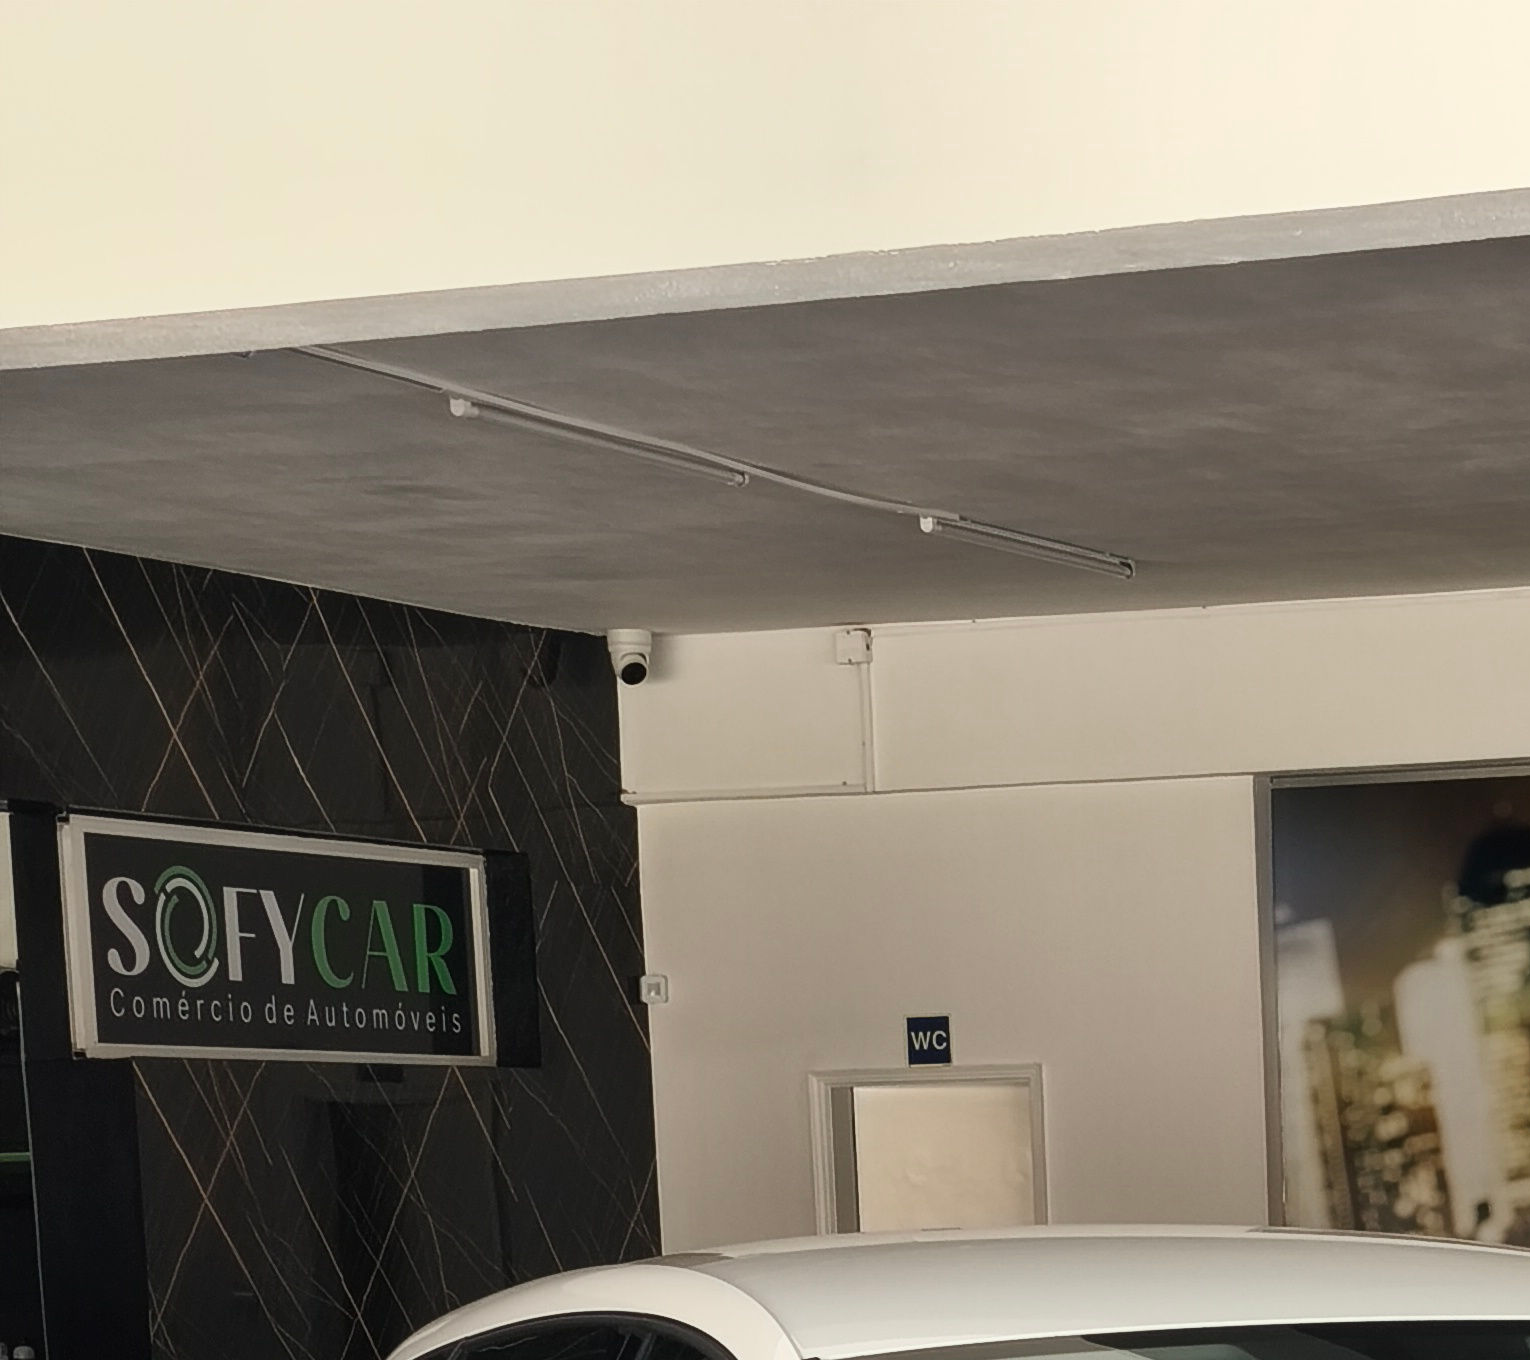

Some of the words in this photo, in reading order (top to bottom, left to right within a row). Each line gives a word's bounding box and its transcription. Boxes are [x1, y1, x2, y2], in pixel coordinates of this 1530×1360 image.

[102, 865, 457, 995] SOFYCAR
[110, 987, 252, 1023] Comércio
[264, 999, 295, 1025] de
[306, 999, 462, 1034] Automóveis
[910, 1030, 947, 1050] WC
